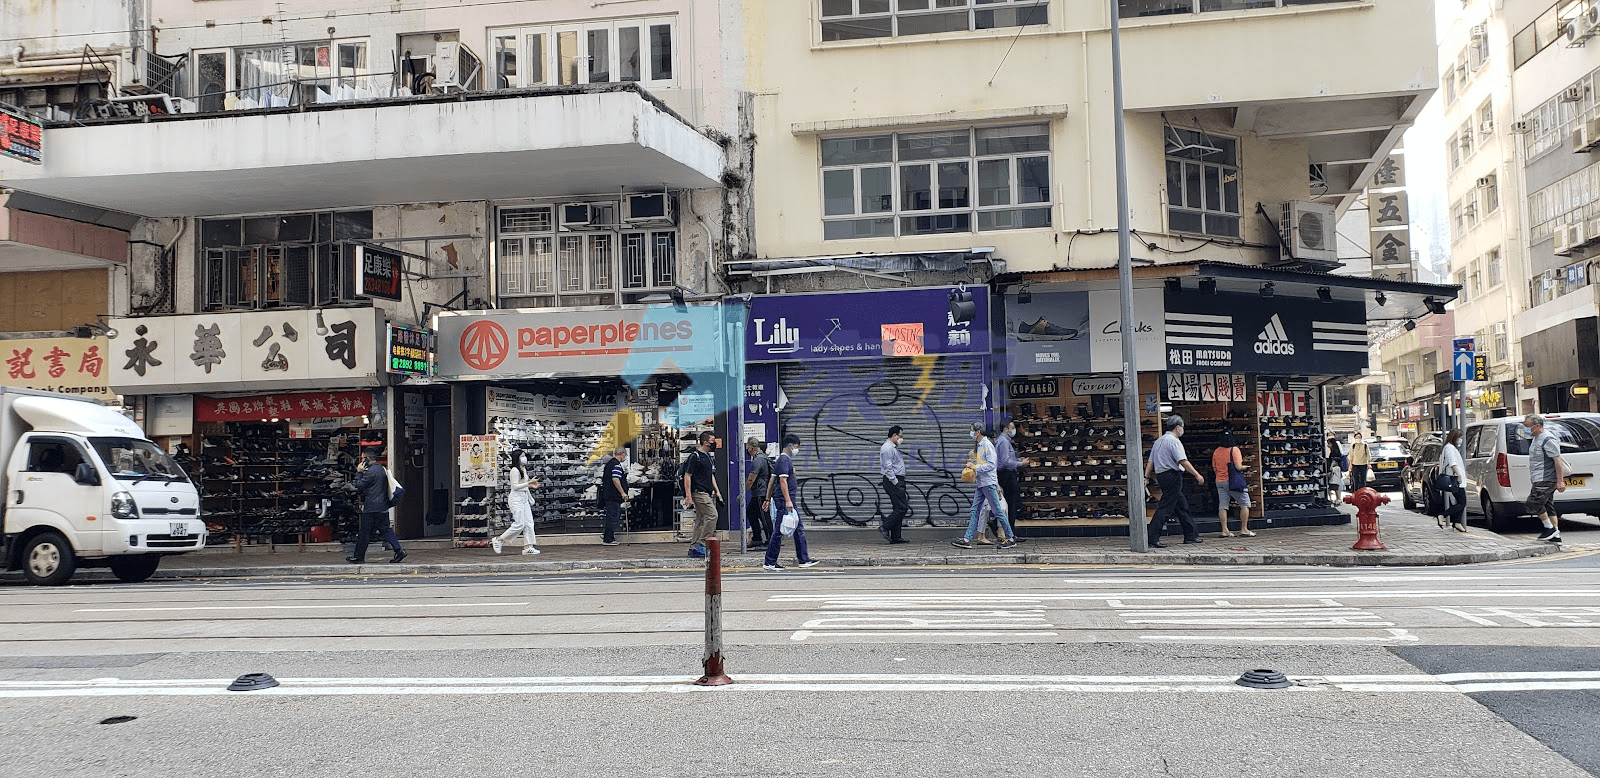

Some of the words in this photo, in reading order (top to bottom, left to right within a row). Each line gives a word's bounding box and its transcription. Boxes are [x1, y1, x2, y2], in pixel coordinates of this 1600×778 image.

[364, 253, 392, 278] 足康樂
[518, 320, 693, 349] paperplanes
[754, 318, 801, 353] Lily
[810, 344, 828, 353] lady
[830, 340, 855, 352] shoes
[857, 343, 863, 351] &
[123, 320, 357, 377] 永華公司
[1169, 348, 1193, 365] 松田
[1195, 350, 1232, 360] MATSUDA
[1253, 340, 1295, 356] adidas
[5, 345, 104, 379] 記書局
[58, 385, 107, 394] Company
[1077, 381, 1116, 393] forum
[1168, 373, 1245, 400] 全場大賤賣
[1257, 390, 1307, 417] SALE
